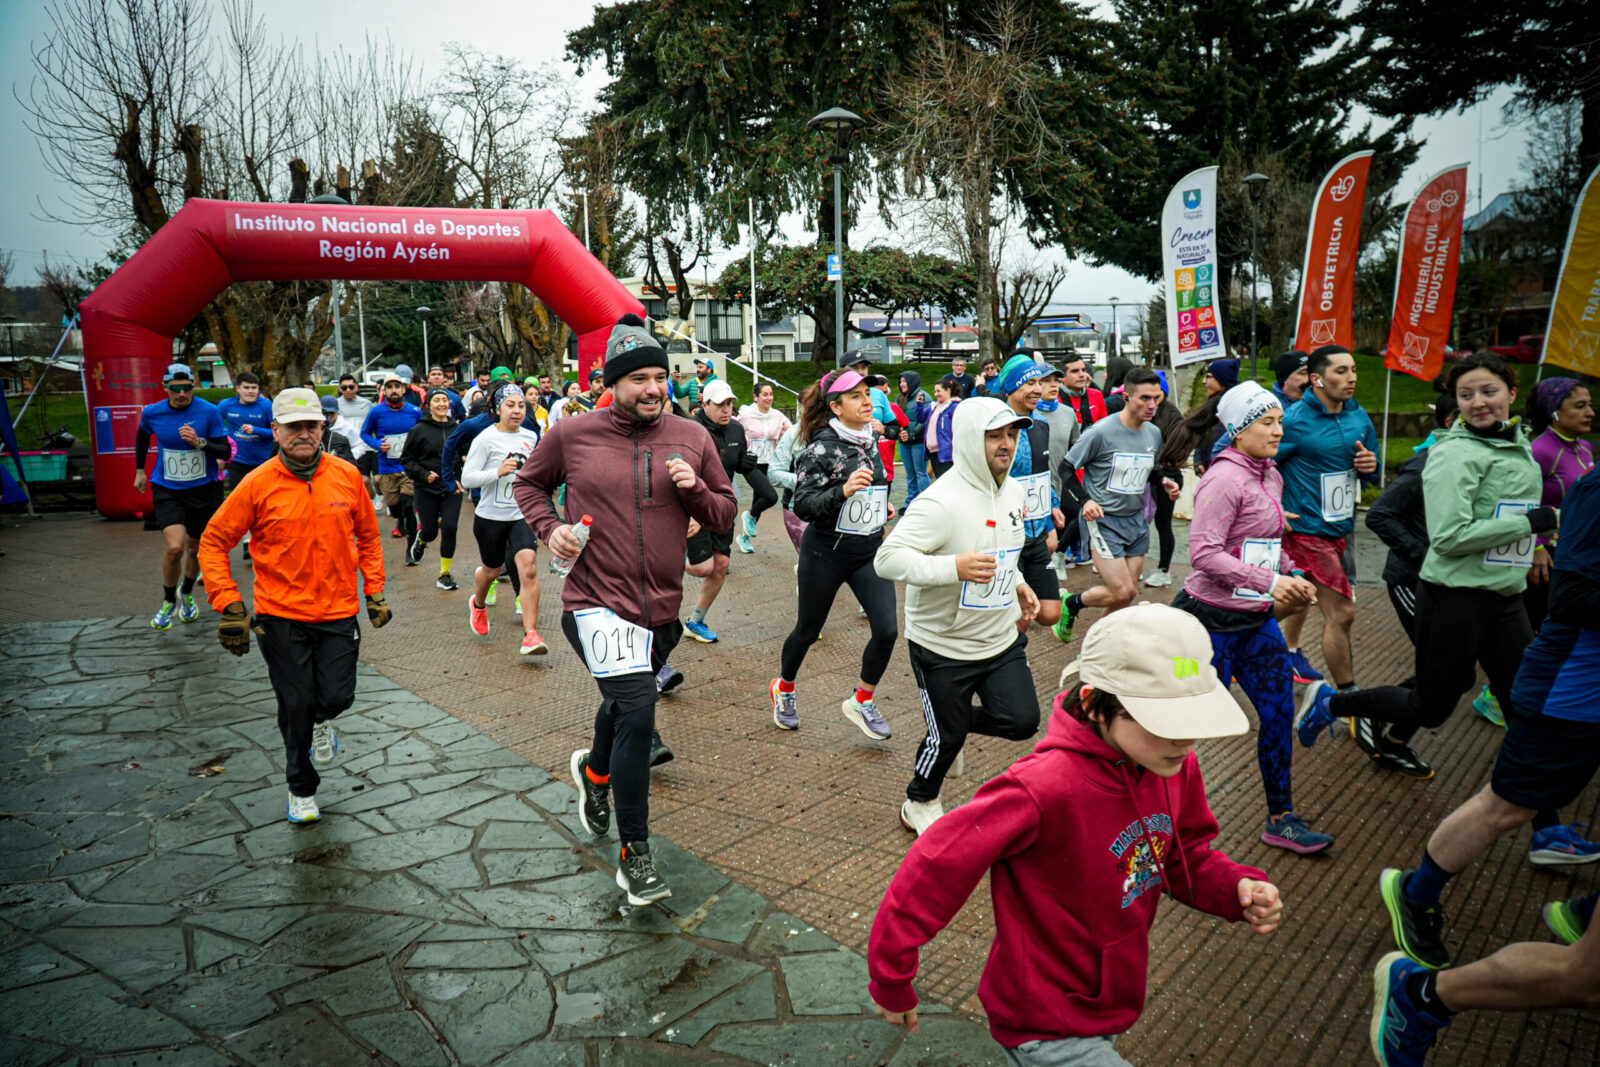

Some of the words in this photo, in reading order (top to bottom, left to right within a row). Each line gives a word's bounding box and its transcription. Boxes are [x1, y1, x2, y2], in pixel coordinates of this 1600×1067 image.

[234, 213, 315, 232] Instituto
[321, 216, 407, 235] Nacional
[413, 218, 436, 235] de
[442, 219, 521, 240] Deportes
[1171, 226, 1214, 248] Crecer
[319, 239, 386, 262] Región
[393, 241, 450, 263] Aysén
[1320, 216, 1343, 311] OBSTETRICIA
[1410, 254, 1434, 327] INGENIERÍA
[1424, 223, 1439, 253] CIVIL
[1424, 237, 1450, 313] INDUSTRIAL
[167, 456, 202, 476] 058
[848, 500, 881, 524] 087
[592, 627, 635, 664] 014
[1109, 819, 1144, 859] MAUI
